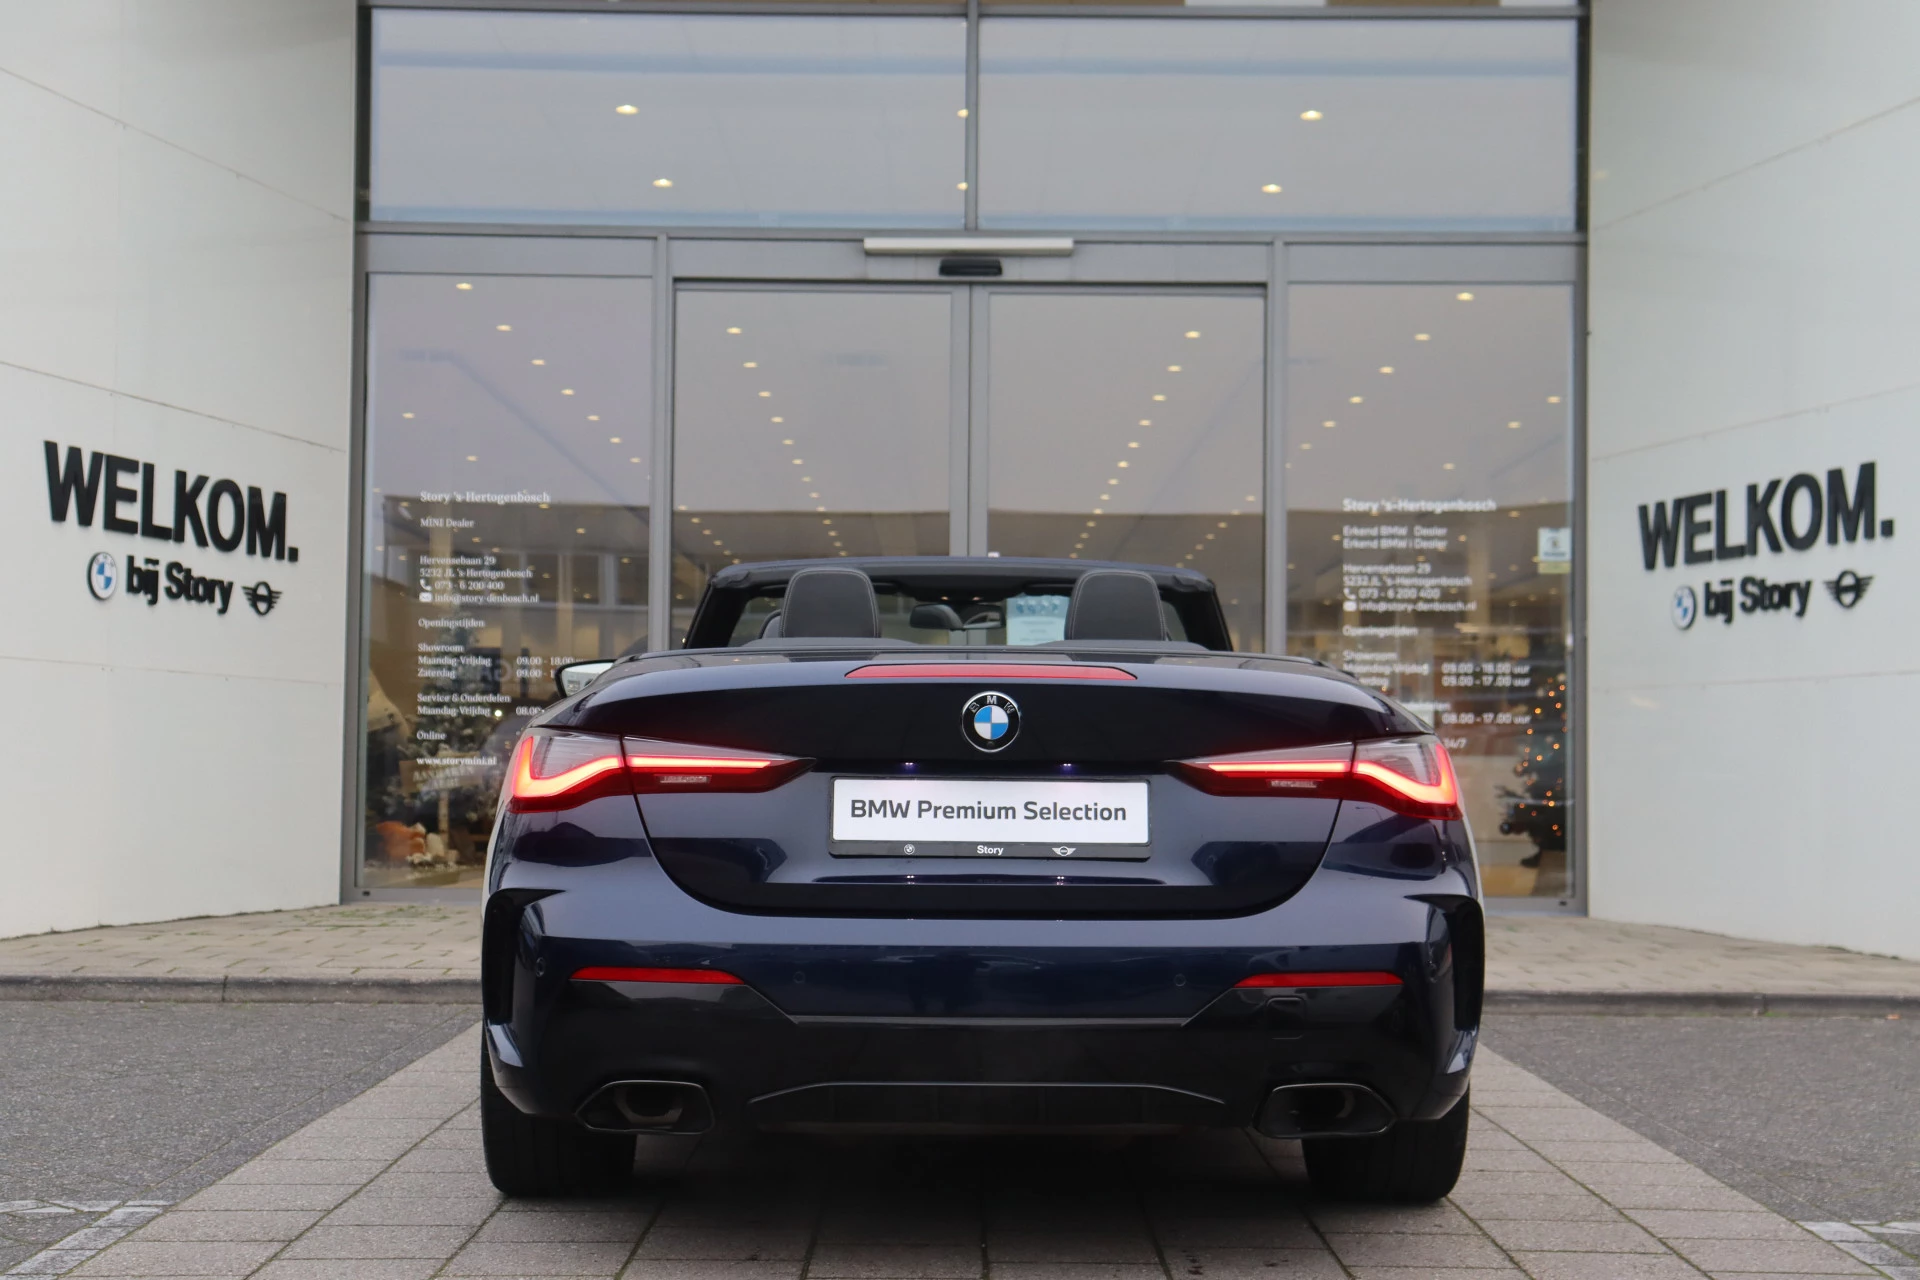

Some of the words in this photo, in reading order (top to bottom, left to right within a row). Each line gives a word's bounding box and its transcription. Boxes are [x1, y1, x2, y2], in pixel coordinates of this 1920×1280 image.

[44, 440, 299, 562] WELKOM.
[420, 491, 450, 505] Story
[1343, 498, 1380, 513] Story
[1638, 461, 1894, 572] WELKOM.
[420, 518, 445, 528] MINI
[446, 518, 475, 528] Dealer
[1380, 525, 1408, 537] BMW
[1380, 538, 1408, 549] BMW
[484, 556, 497, 565] 29
[420, 568, 442, 578] 5232
[127, 555, 159, 606] bij
[164, 561, 234, 615] Story
[467, 581, 485, 590] 200
[486, 581, 505, 590] 400
[1704, 579, 1735, 625] bij
[1740, 576, 1813, 618] Story
[418, 618, 485, 629] Openingstijden
[417, 643, 464, 652] Showroom
[516, 656, 543, 666] 09.00
[417, 668, 456, 679] Zaterdag
[516, 669, 543, 678] 09.00
[417, 693, 450, 702] Service
[460, 693, 512, 703] Onderdelen
[969, 695, 1016, 714] BMW
[416, 730, 447, 740] Online
[416, 756, 497, 767] www.storymini.nl
[851, 799, 911, 819] BMW
[917, 800, 1017, 820] Premium
[1023, 801, 1127, 821] Selection
[976, 844, 1004, 856] Story
